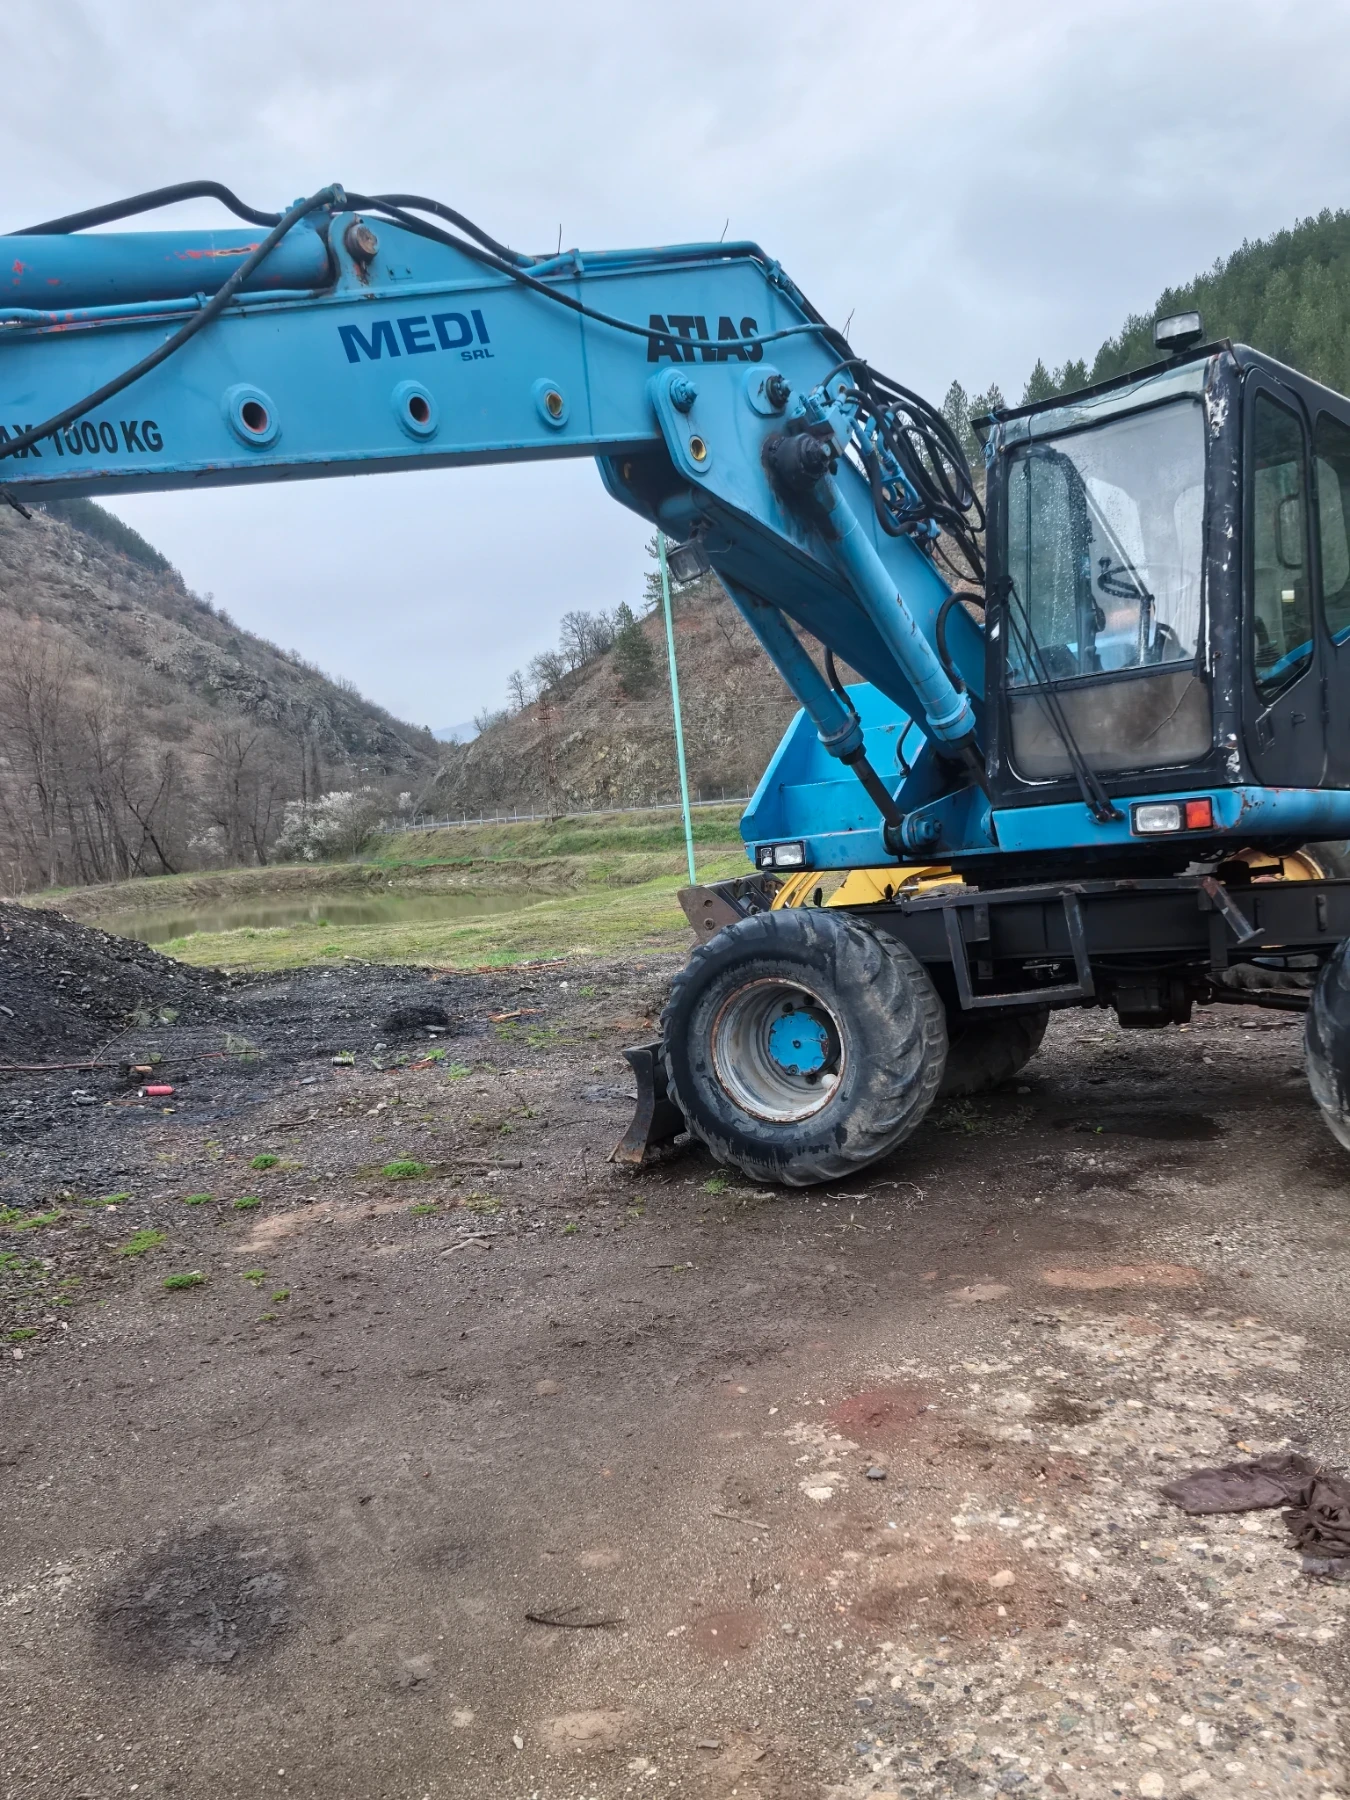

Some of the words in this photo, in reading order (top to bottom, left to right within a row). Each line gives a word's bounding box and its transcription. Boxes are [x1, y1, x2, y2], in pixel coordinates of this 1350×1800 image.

[338, 309, 490, 363] MEDI
[460, 348, 494, 361] SRL
[647, 314, 764, 363] ATLAS
[48, 421, 118, 456] 1000
[119, 420, 164, 453] KG
